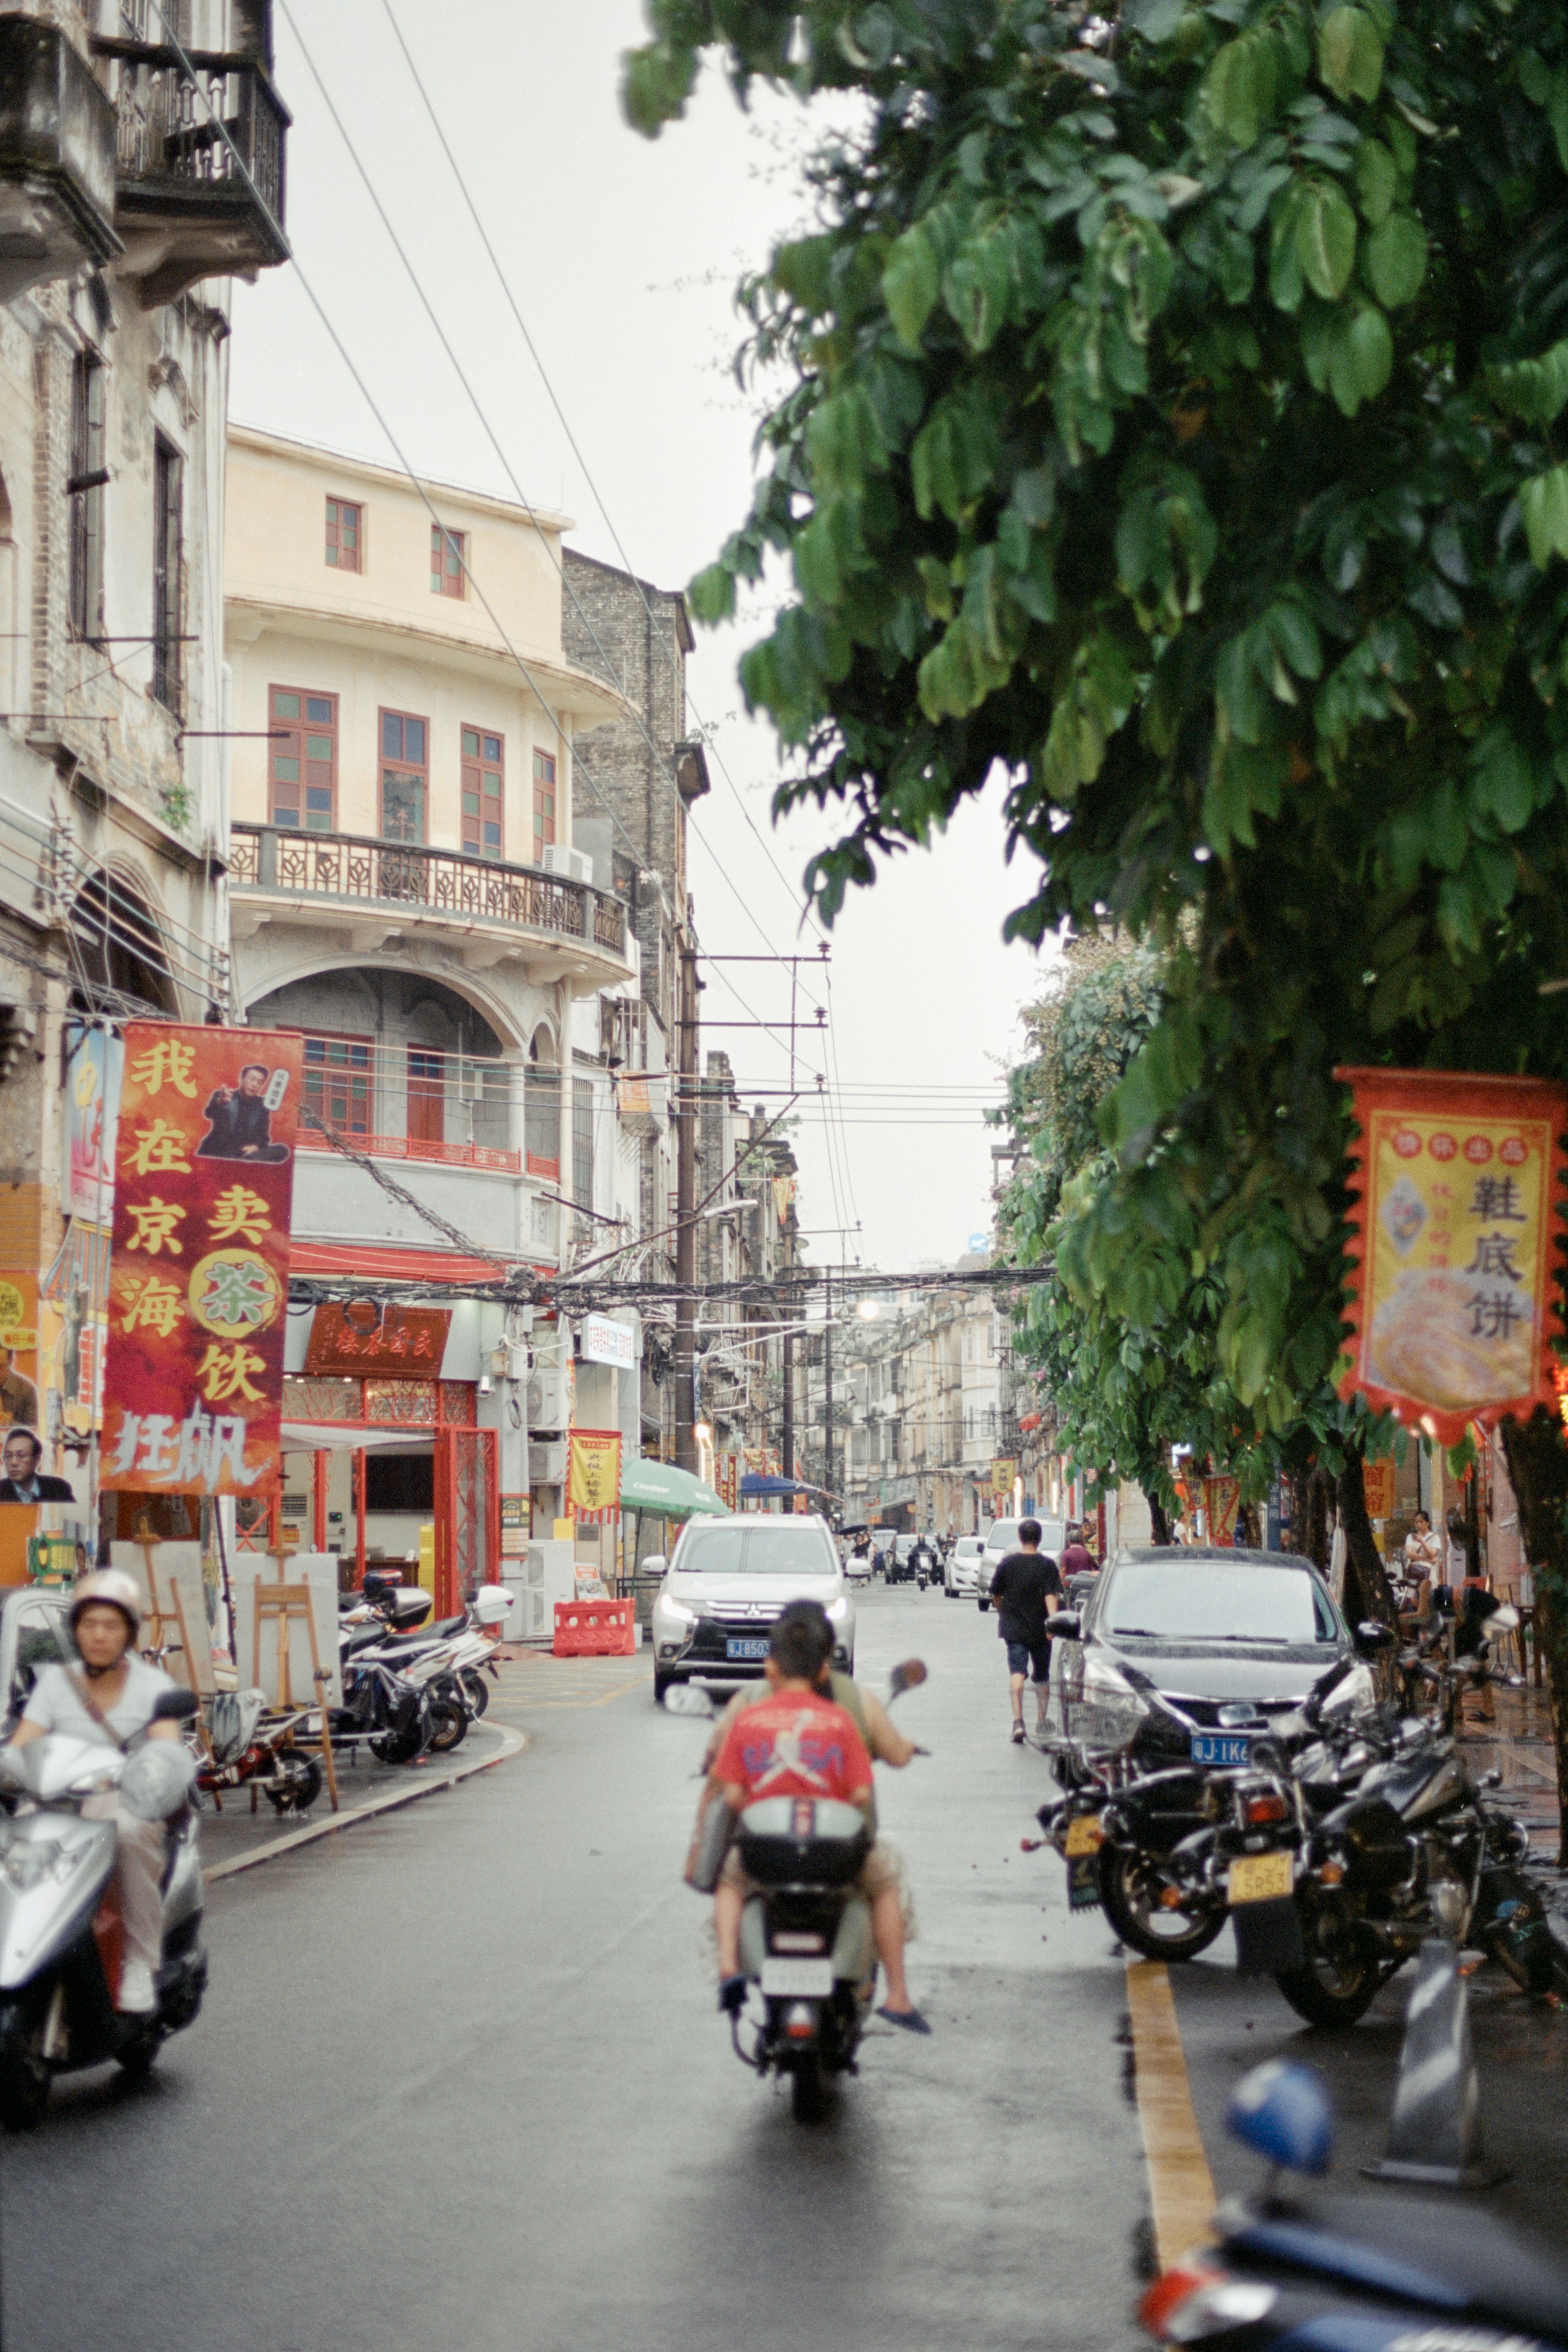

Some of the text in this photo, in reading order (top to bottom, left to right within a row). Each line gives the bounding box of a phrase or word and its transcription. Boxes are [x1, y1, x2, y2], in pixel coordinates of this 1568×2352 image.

[120, 1039, 198, 1337] 我在京海
[1467, 1175, 1528, 1340] 鞋底饼
[196, 1185, 275, 1402] 卖茶饮
[728, 1643, 771, 1655] 粤J·8503
